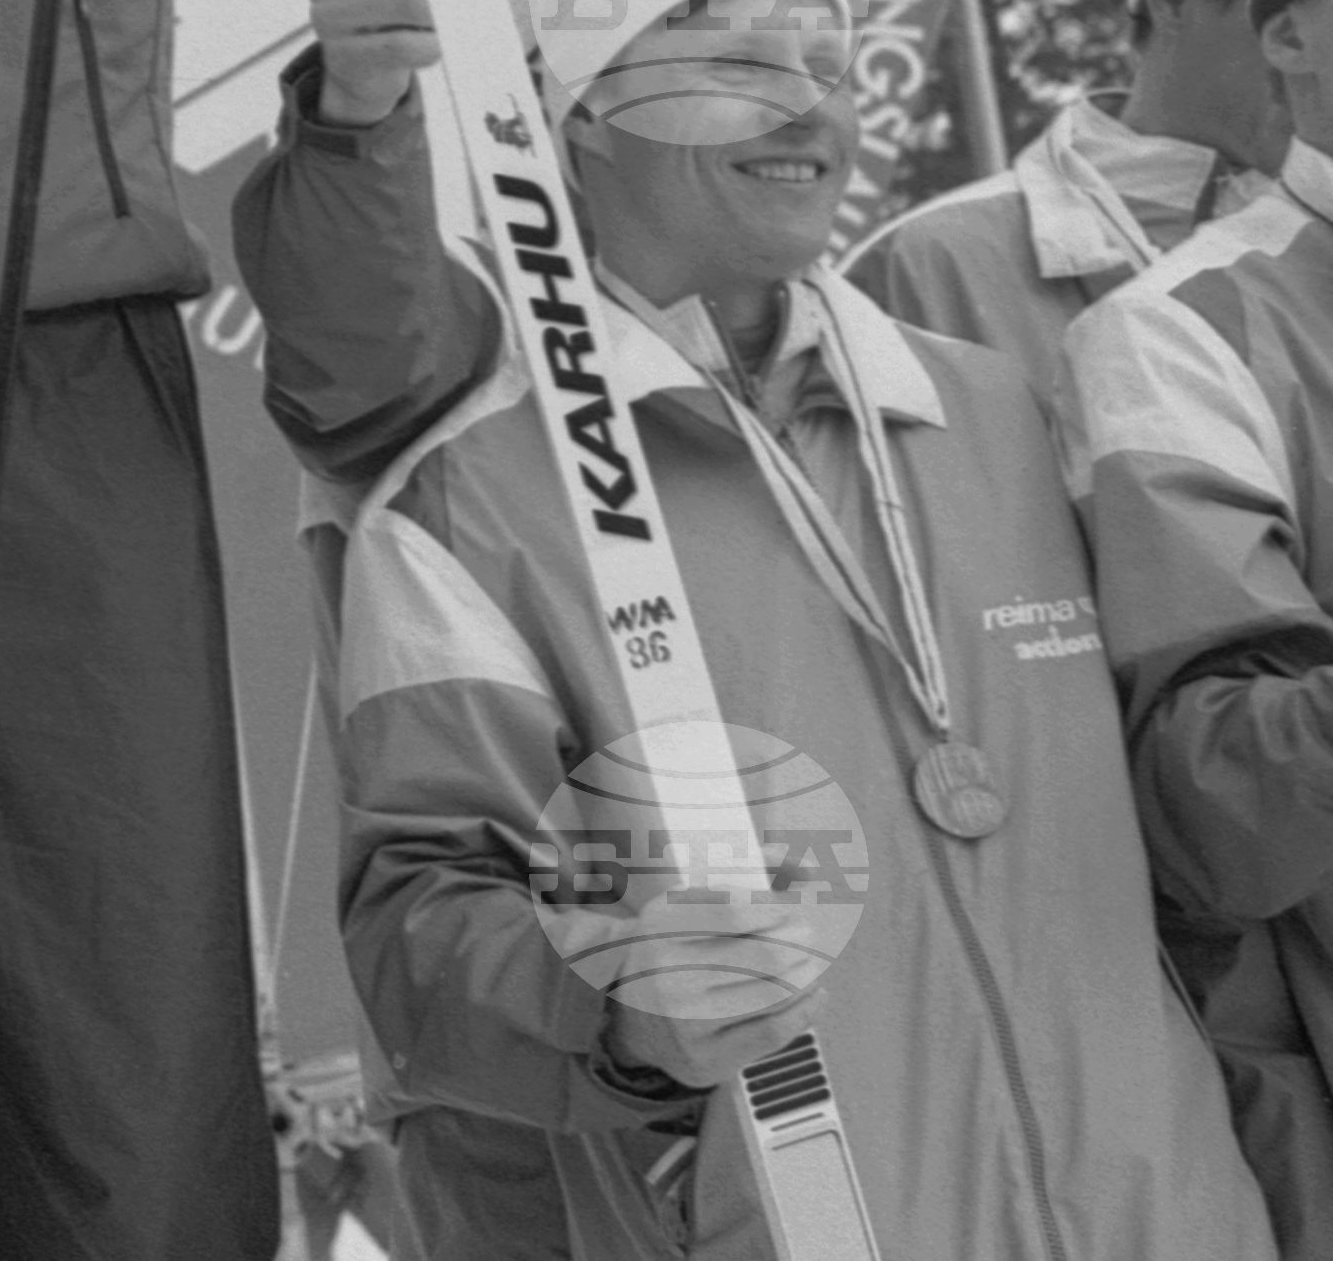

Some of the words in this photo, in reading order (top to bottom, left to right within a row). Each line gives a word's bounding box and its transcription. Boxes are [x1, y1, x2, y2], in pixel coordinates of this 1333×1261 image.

[492, 172, 653, 542] KARHU
[604, 595, 676, 635] WM
[983, 595, 1077, 631] reima
[625, 630, 672, 669] 86
